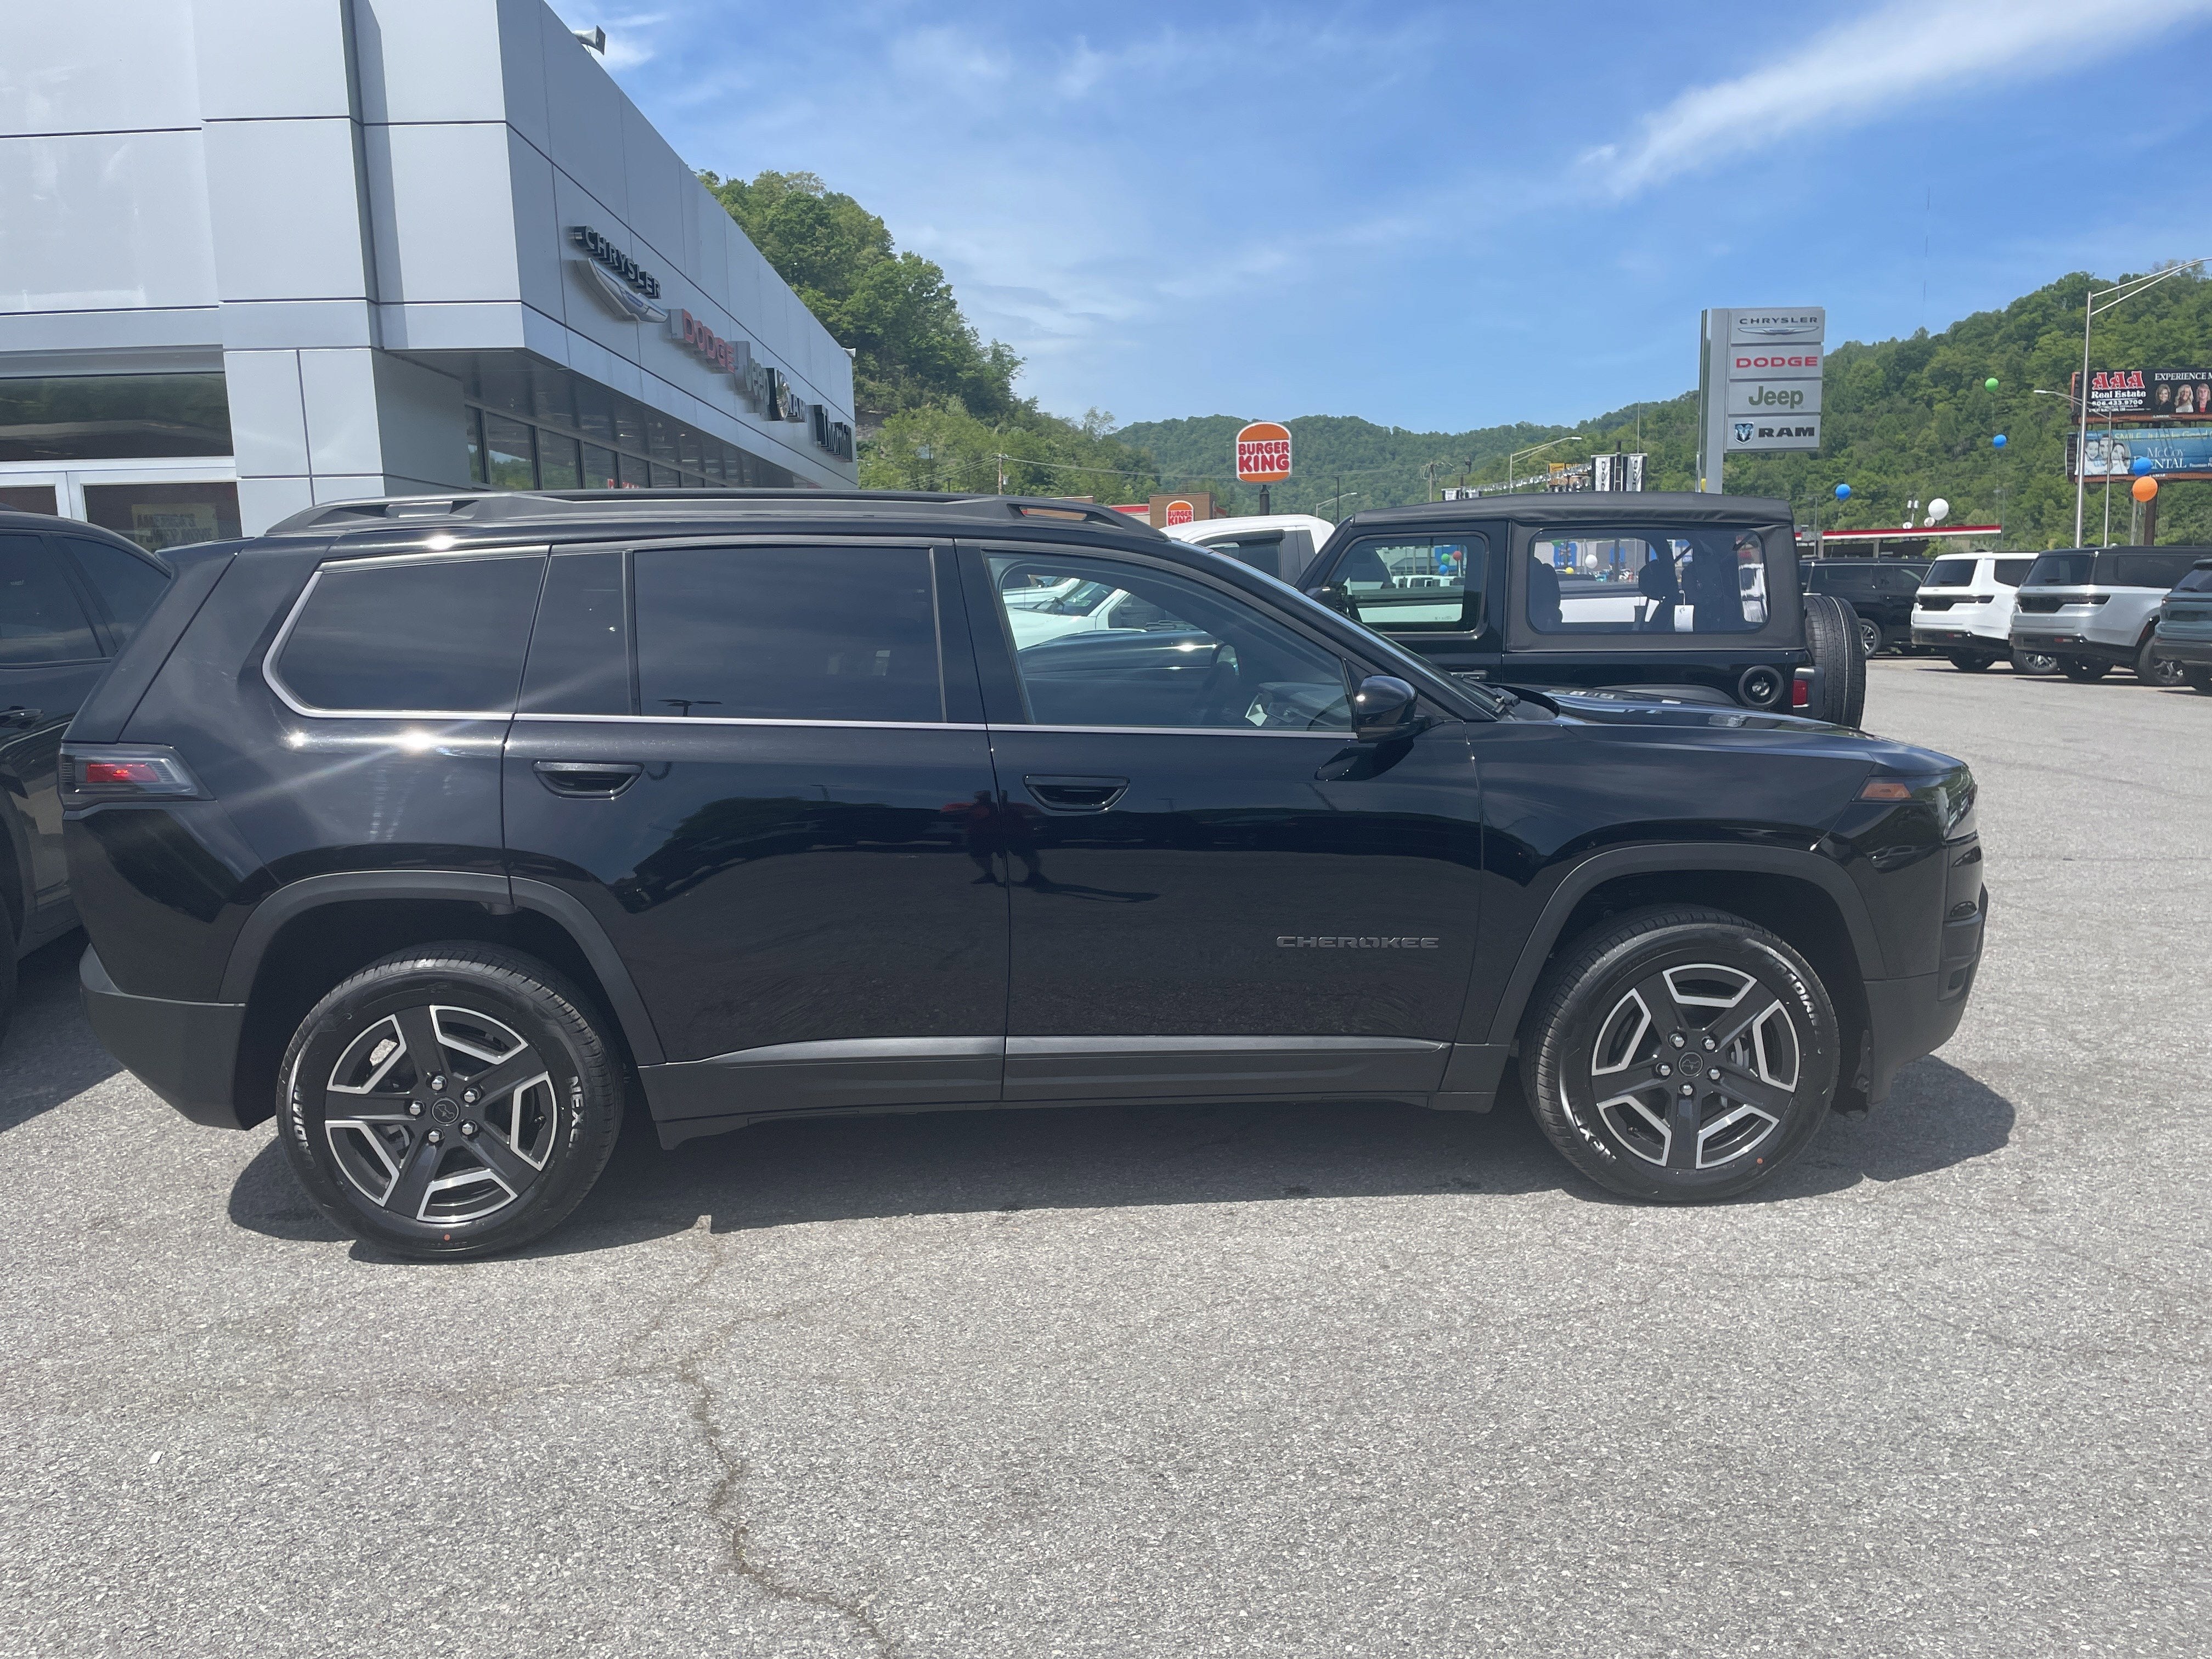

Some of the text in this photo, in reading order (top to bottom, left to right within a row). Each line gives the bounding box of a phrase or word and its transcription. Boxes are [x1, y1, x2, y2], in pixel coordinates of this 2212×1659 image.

[584, 226, 662, 300] CHRYSLER
[1739, 317, 1818, 325] CHRYSLER
[682, 308, 735, 374] DODGE
[1736, 356, 1818, 368] DODGE
[2092, 370, 2146, 390] AAA
[2154, 372, 2207, 381] EXPERIENCE
[1748, 386, 1804, 409] Jeep
[2091, 390, 2146, 399] Real Estate
[1758, 426, 1815, 438] RAM
[1238, 441, 1289, 455] BURGER
[1239, 454, 1289, 472] KING
[1167, 516, 1192, 526] KING
[1276, 935, 1440, 949] CHEROKEE
